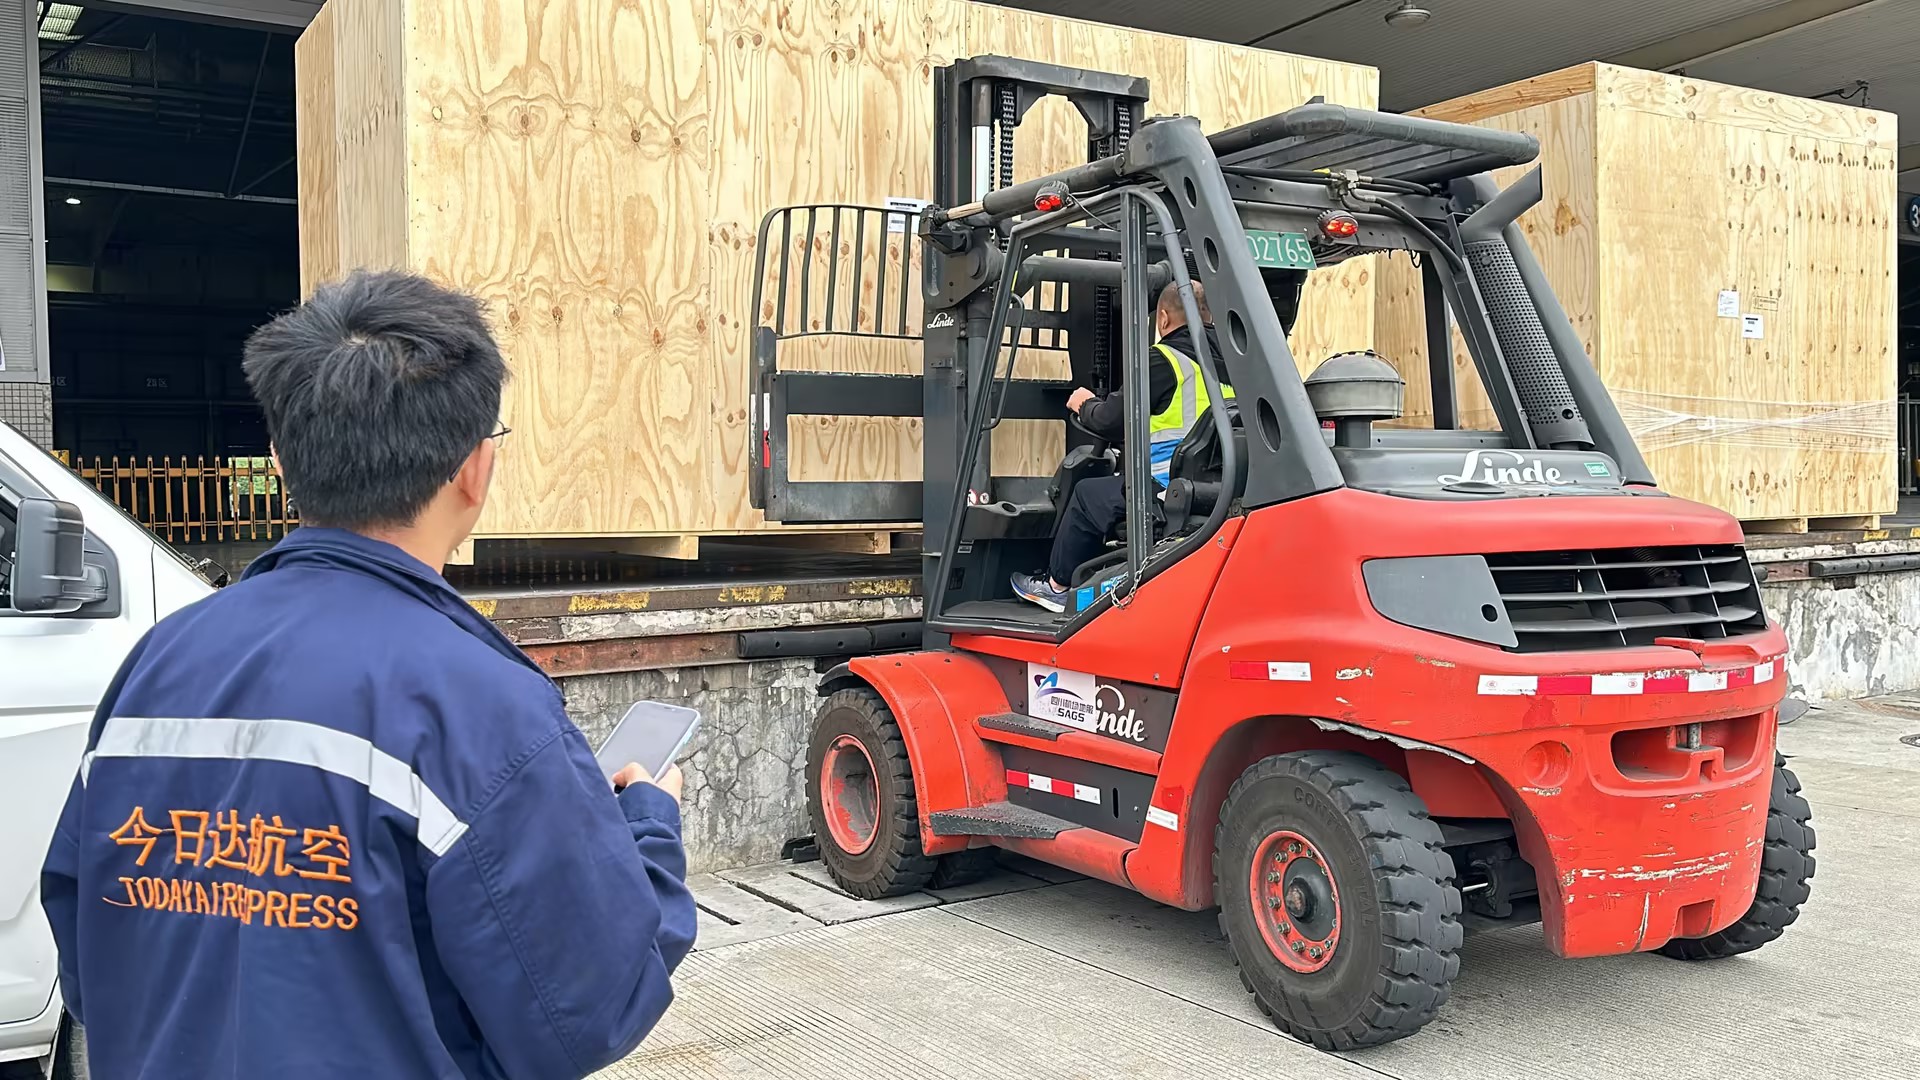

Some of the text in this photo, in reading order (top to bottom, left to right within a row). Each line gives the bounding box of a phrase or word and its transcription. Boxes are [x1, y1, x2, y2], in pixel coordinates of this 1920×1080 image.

[927, 312, 955, 329] Linde
[1437, 450, 1571, 485] Linde
[1058, 708, 1085, 722] SAGS
[109, 806, 352, 883] 今日达航空
